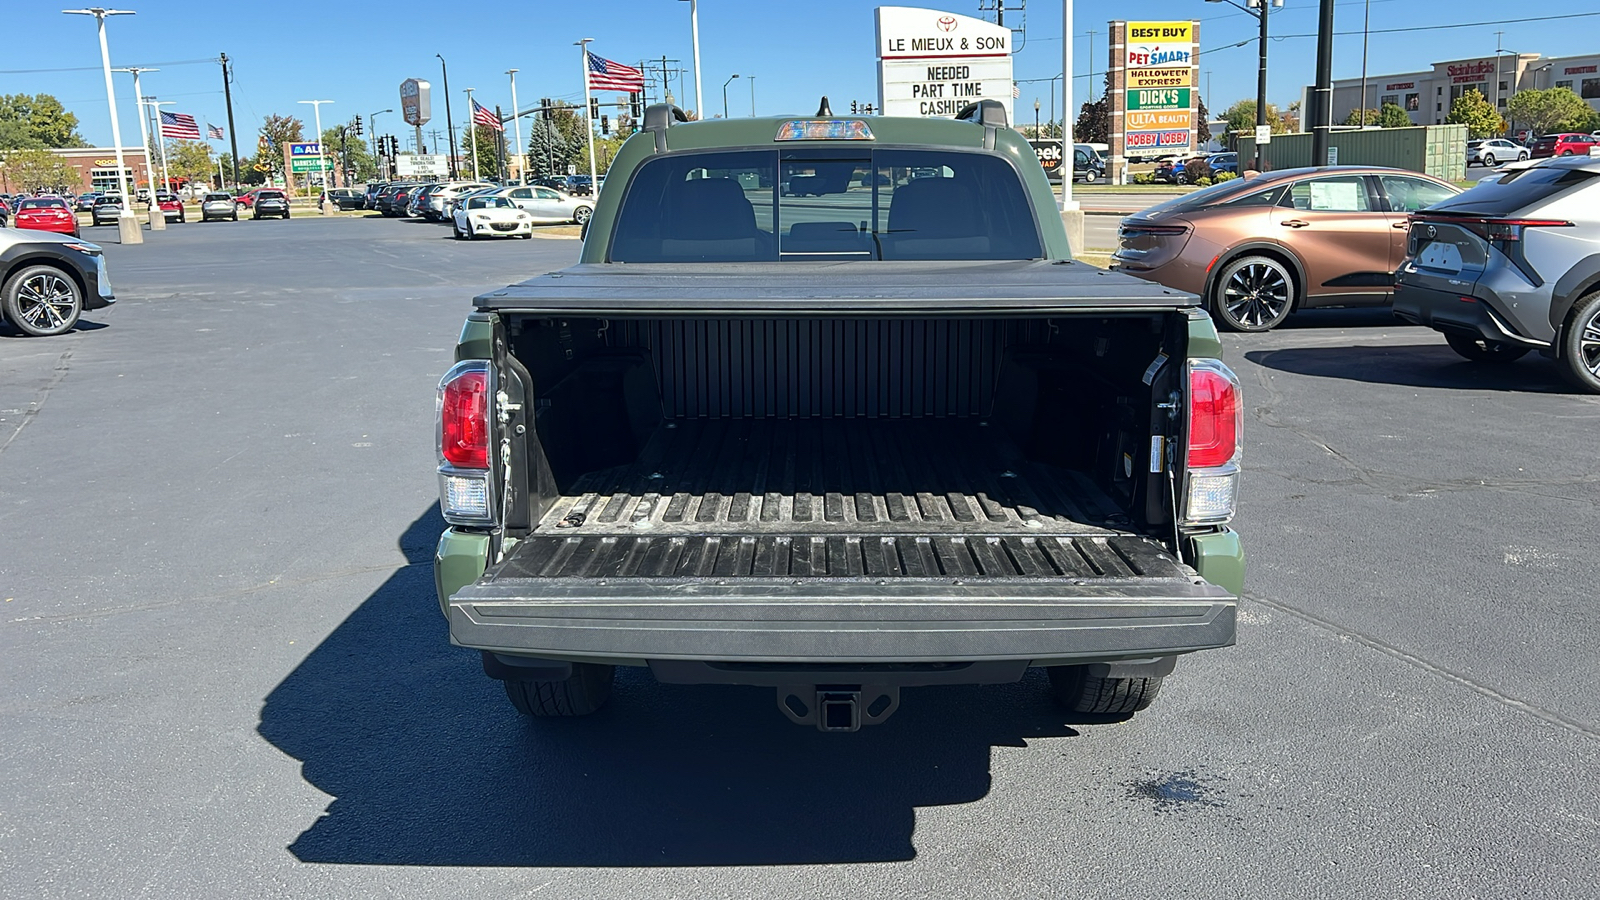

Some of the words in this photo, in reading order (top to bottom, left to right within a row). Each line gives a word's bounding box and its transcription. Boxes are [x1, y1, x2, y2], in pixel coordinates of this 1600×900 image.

[1131, 28, 1160, 37] BEST
[1162, 28, 1187, 37] BUY
[888, 39, 905, 51] LE
[912, 38, 954, 51] MIEUX
[960, 37, 969, 49] &
[976, 37, 1005, 49] SON
[927, 66, 970, 80] NEEDED
[1131, 69, 1188, 78] HALLOWEEN
[1138, 78, 1182, 86] EXPRESS
[913, 84, 945, 98] PART
[952, 82, 982, 97] TIME
[1139, 89, 1179, 105] DICK'S
[1131, 113, 1157, 125] ULTA
[1158, 114, 1188, 124] BEAUTY
[1127, 133, 1157, 146] HOBBY
[1160, 132, 1187, 144] LOBBY
[1034, 145, 1062, 160] eek
